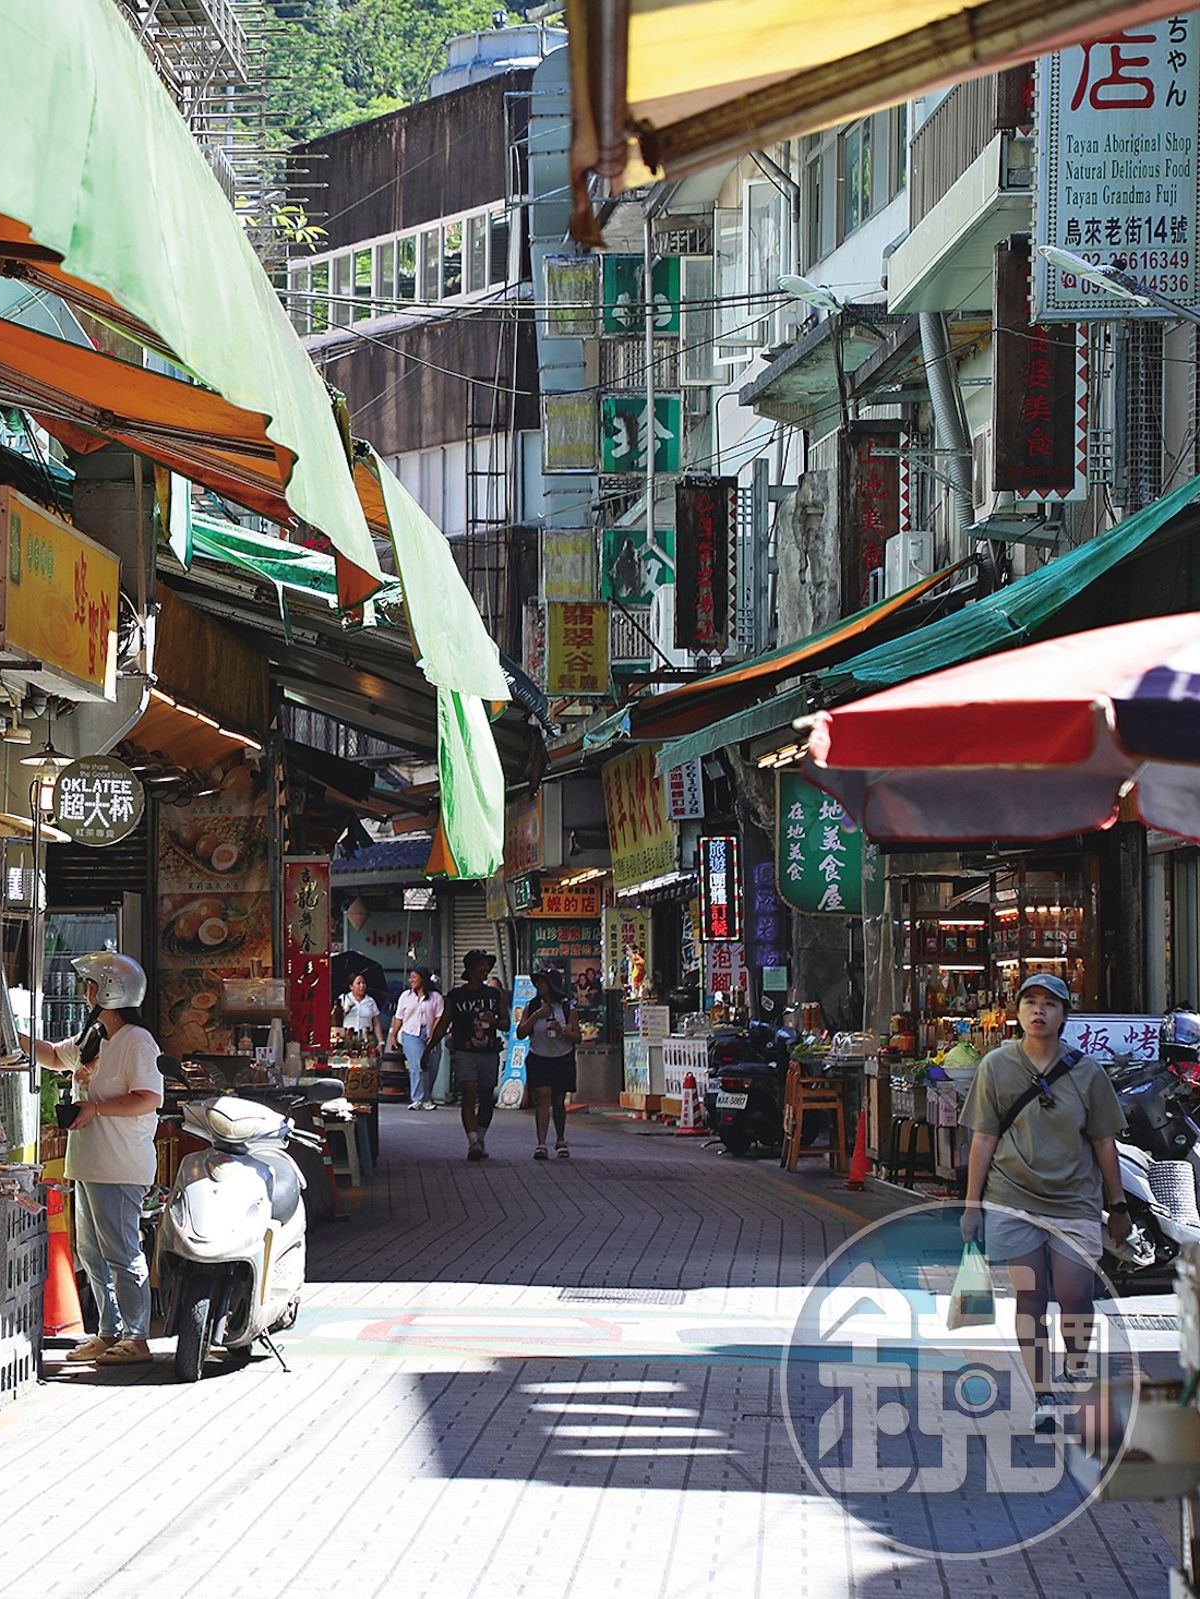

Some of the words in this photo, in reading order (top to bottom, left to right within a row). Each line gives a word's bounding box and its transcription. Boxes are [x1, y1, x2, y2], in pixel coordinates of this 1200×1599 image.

[1066, 134, 1099, 160] Tayan
[1104, 134, 1161, 160] Aboriginal
[1165, 131, 1192, 155] Shop
[1065, 161, 1107, 181] Natural
[1111, 158, 1161, 180] Delicious
[1165, 158, 1191, 179] Food
[1066, 186, 1098, 212] Tayan
[1103, 184, 1152, 205] Grandma
[1156, 183, 1178, 207] Fuji
[1064, 215, 1189, 247] 烏來老街14號
[563, 604, 594, 673] 翡翠谷
[61, 777, 132, 794] OKLATEE
[59, 791, 134, 828] 超大杯
[786, 802, 806, 881] 在地美食
[817, 790, 847, 911] 地美食屋
[531, 896, 596, 913] 嬤的店
[708, 840, 729, 937] 旅遊團體訂餐
